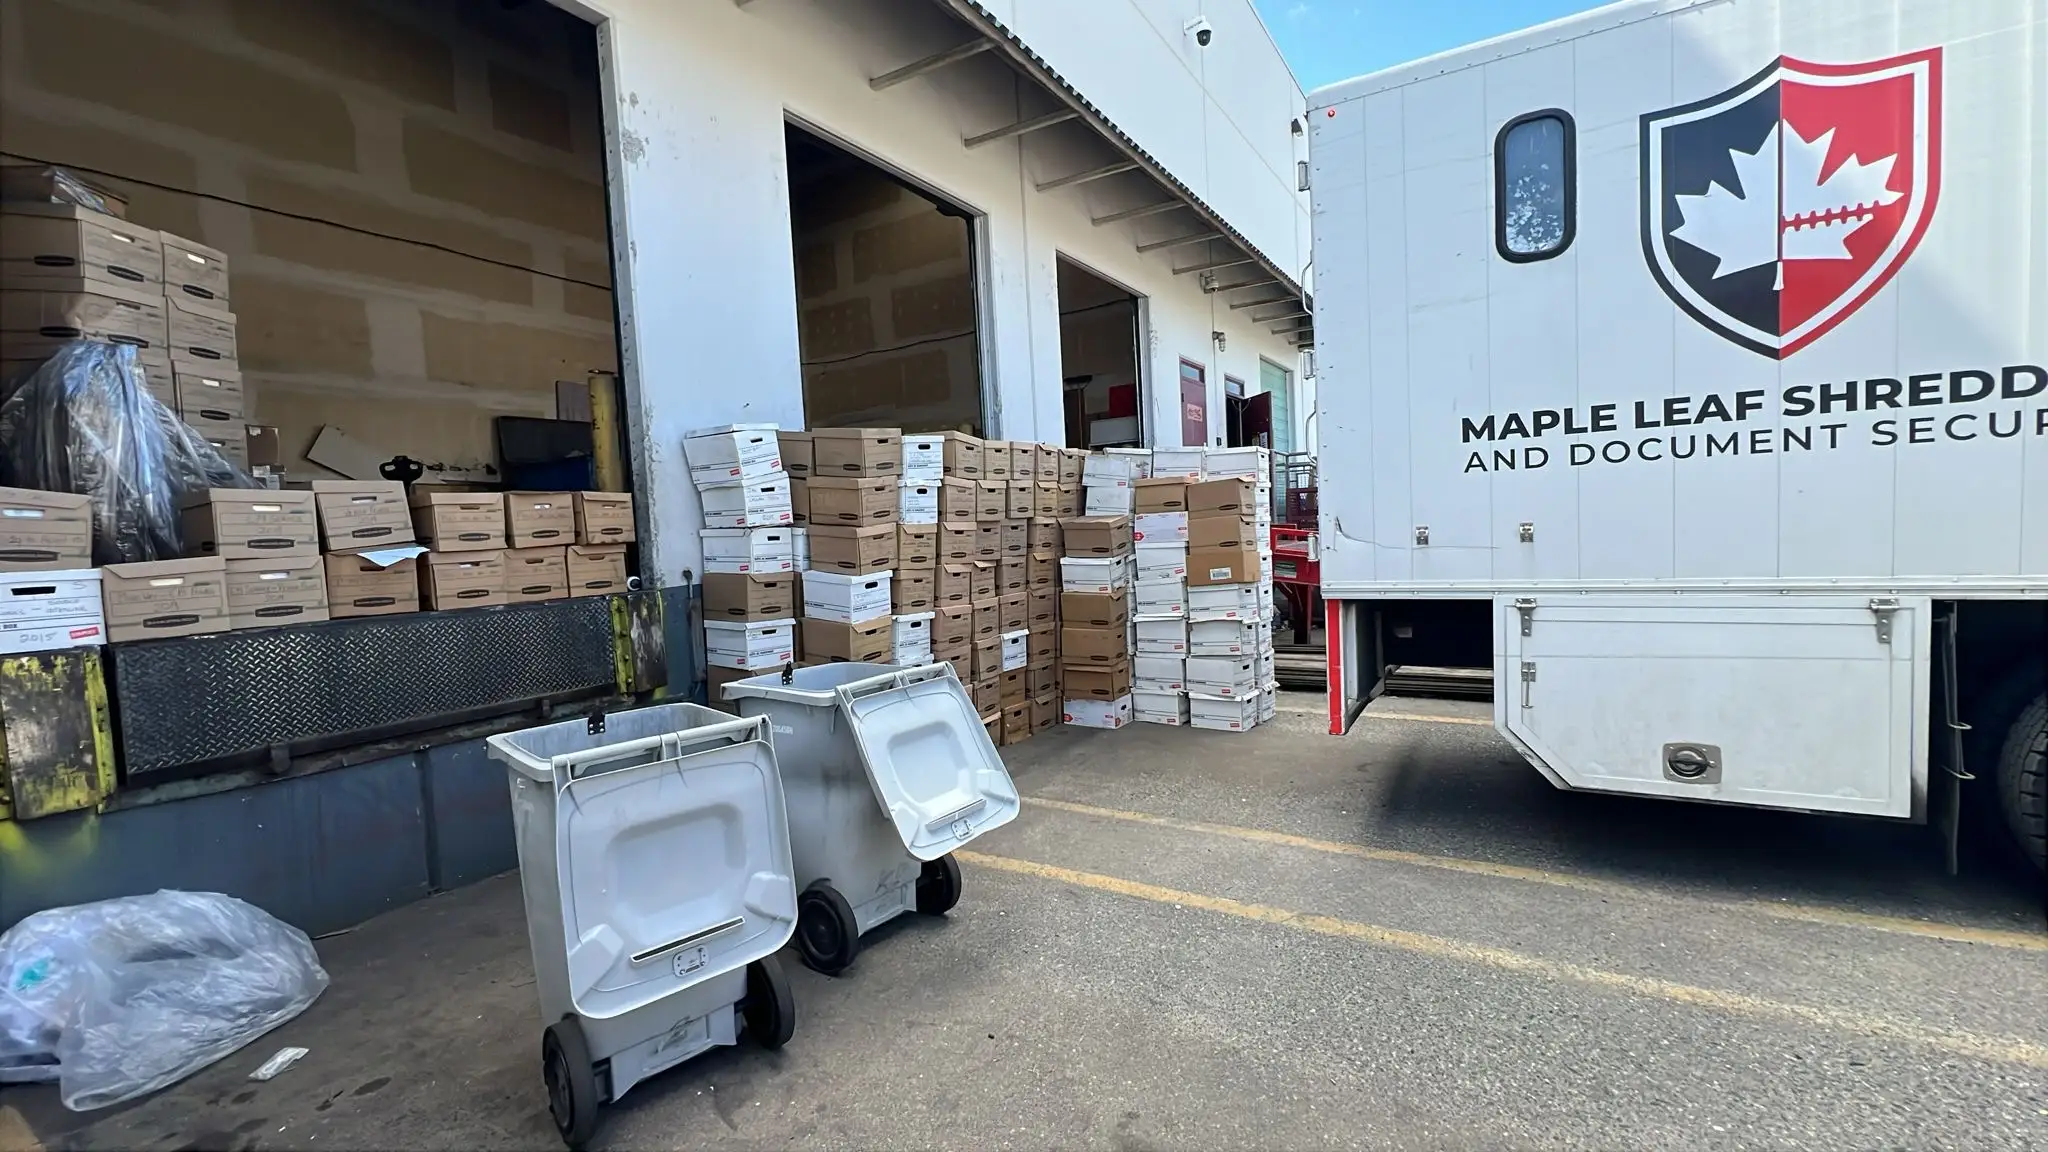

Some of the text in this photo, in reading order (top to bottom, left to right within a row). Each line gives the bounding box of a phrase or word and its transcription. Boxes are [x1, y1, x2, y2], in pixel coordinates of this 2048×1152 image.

[1461, 365, 2048, 444] MAPLE LEAF SHREDD
[1464, 446, 1549, 474] AND
[1569, 423, 1848, 466] DOCUMENT
